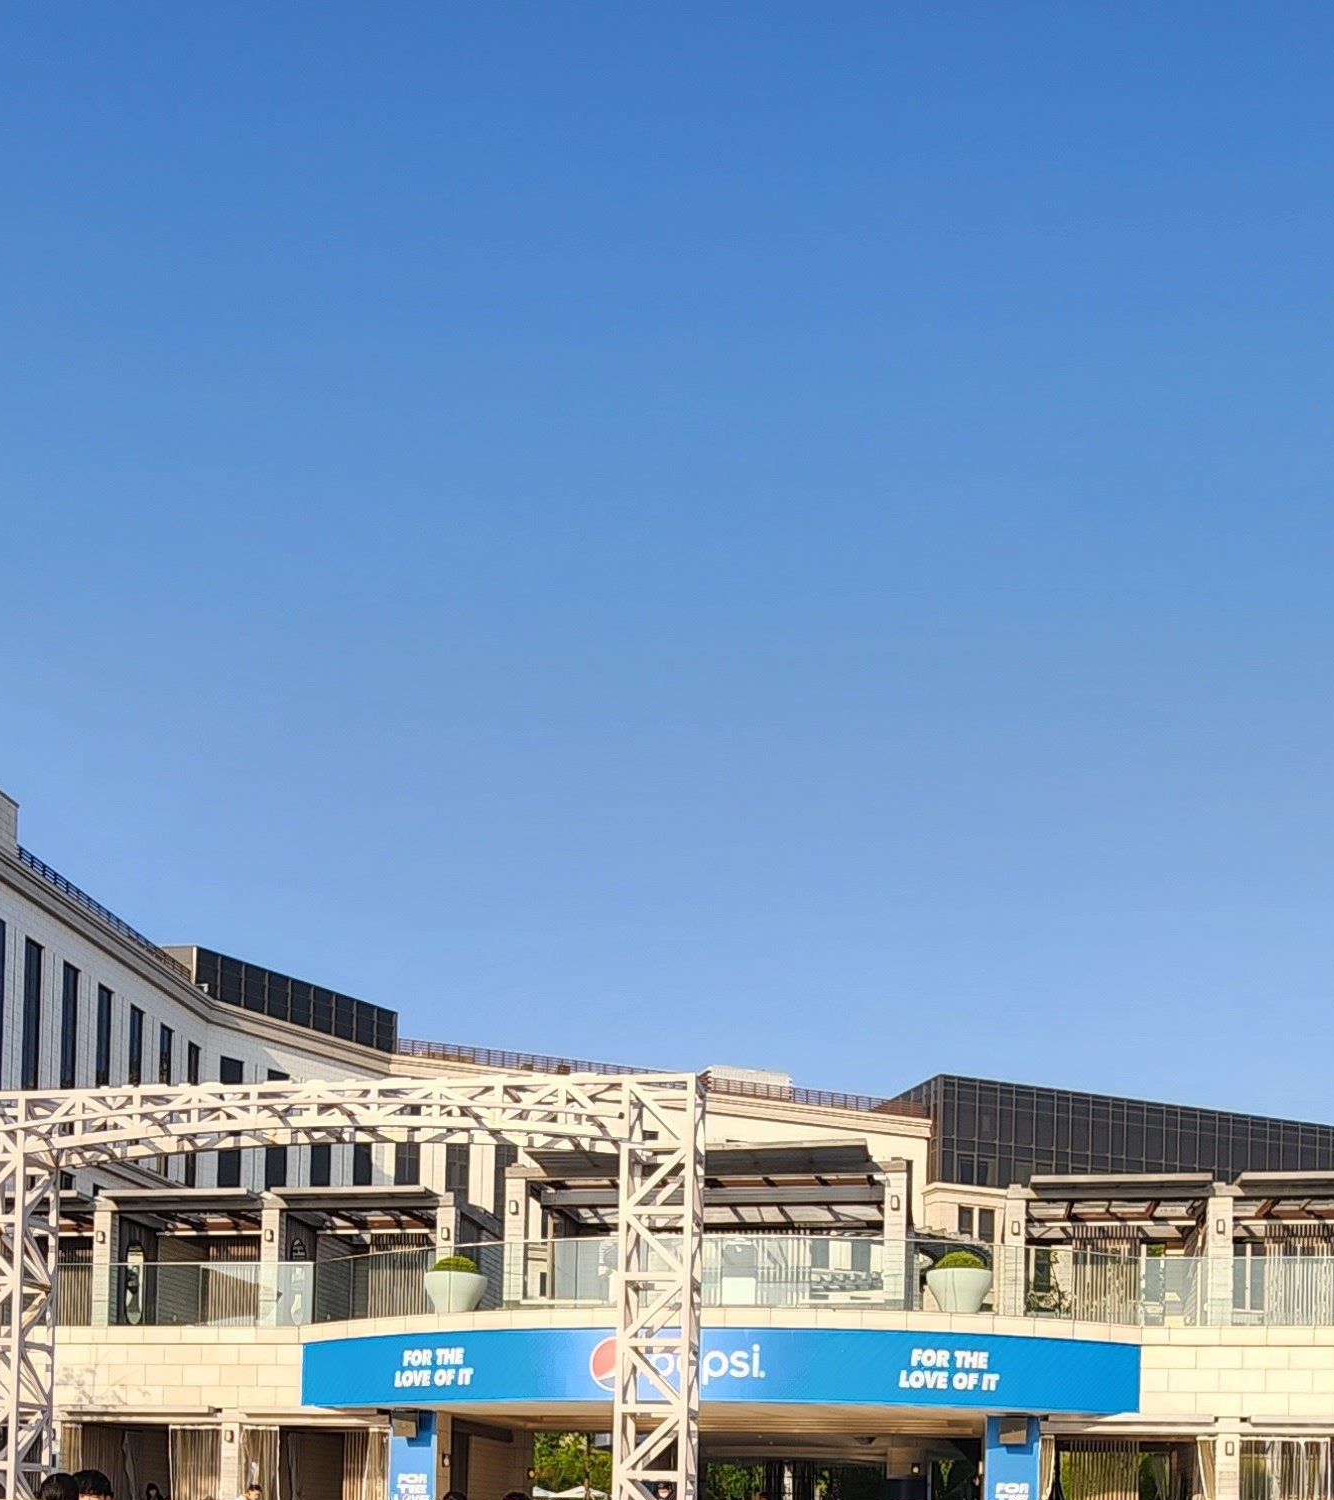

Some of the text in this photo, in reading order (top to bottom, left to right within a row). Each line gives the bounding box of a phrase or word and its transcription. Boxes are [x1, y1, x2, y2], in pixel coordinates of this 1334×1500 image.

[403, 1347, 465, 1366] FOR THE
[911, 1348, 989, 1369] FOR THE
[394, 1368, 474, 1387] LOVE OF IT
[899, 1370, 1000, 1391] LOVE OF IT
[397, 1473, 428, 1484] FOR
[996, 1483, 1029, 1493] FOR
[397, 1484, 428, 1494] THE
